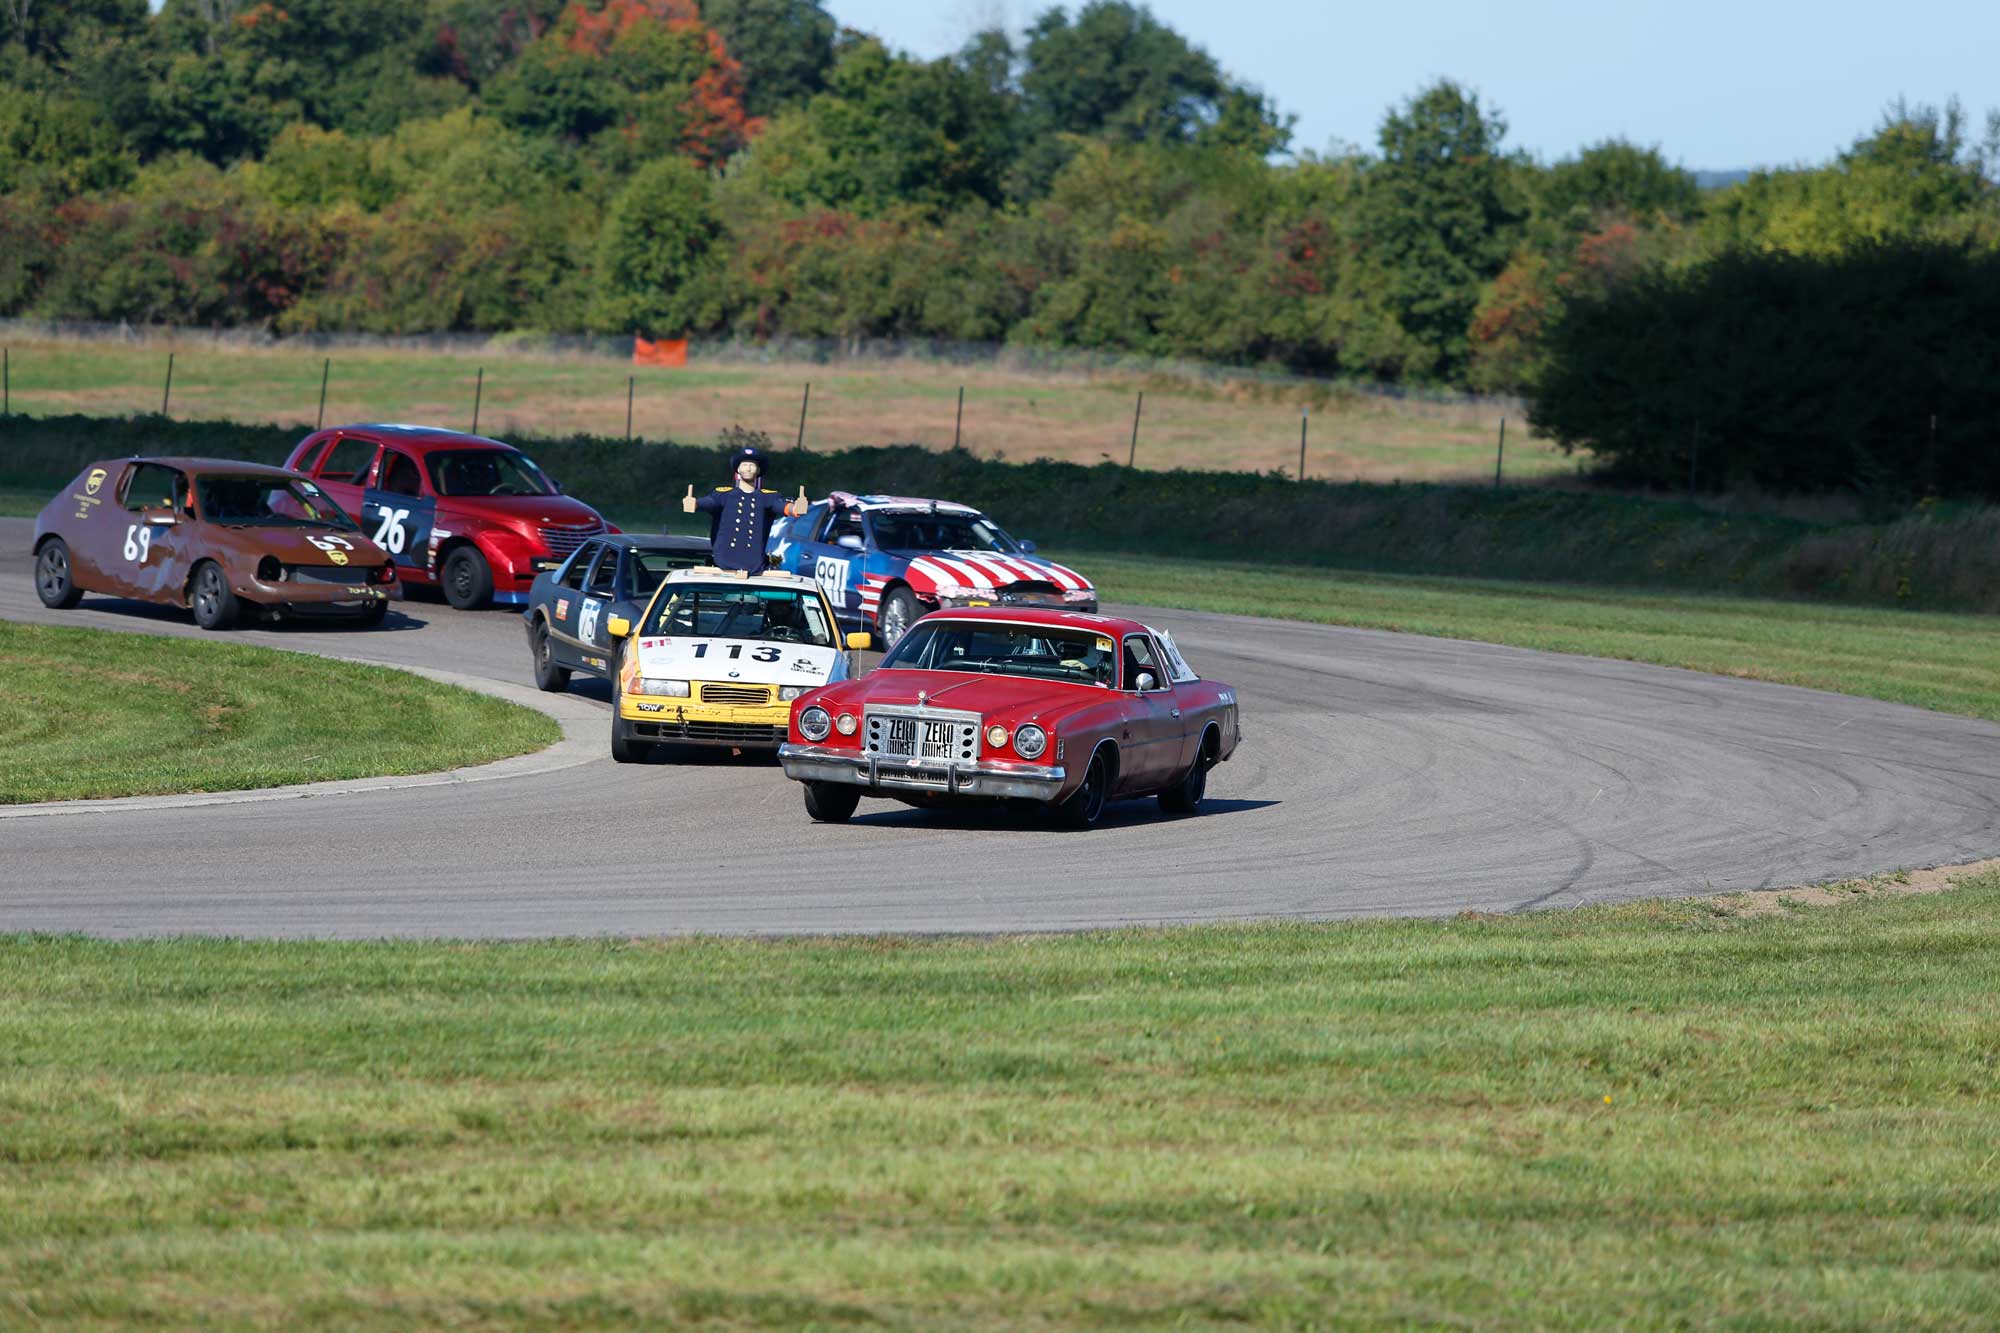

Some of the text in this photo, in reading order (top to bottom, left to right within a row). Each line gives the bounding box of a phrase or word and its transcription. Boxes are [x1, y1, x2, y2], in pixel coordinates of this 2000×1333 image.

[372, 506, 410, 554] 26
[124, 525, 151, 563] 69
[306, 536, 354, 550] 69
[818, 561, 843, 603] 991
[692, 643, 782, 662] 113
[638, 704, 660, 712] TOW
[889, 719, 916, 743] ZERO
[925, 722, 954, 745] ZERO
[887, 739, 915, 756] BUDGET
[921, 742, 953, 759] BUDGET
